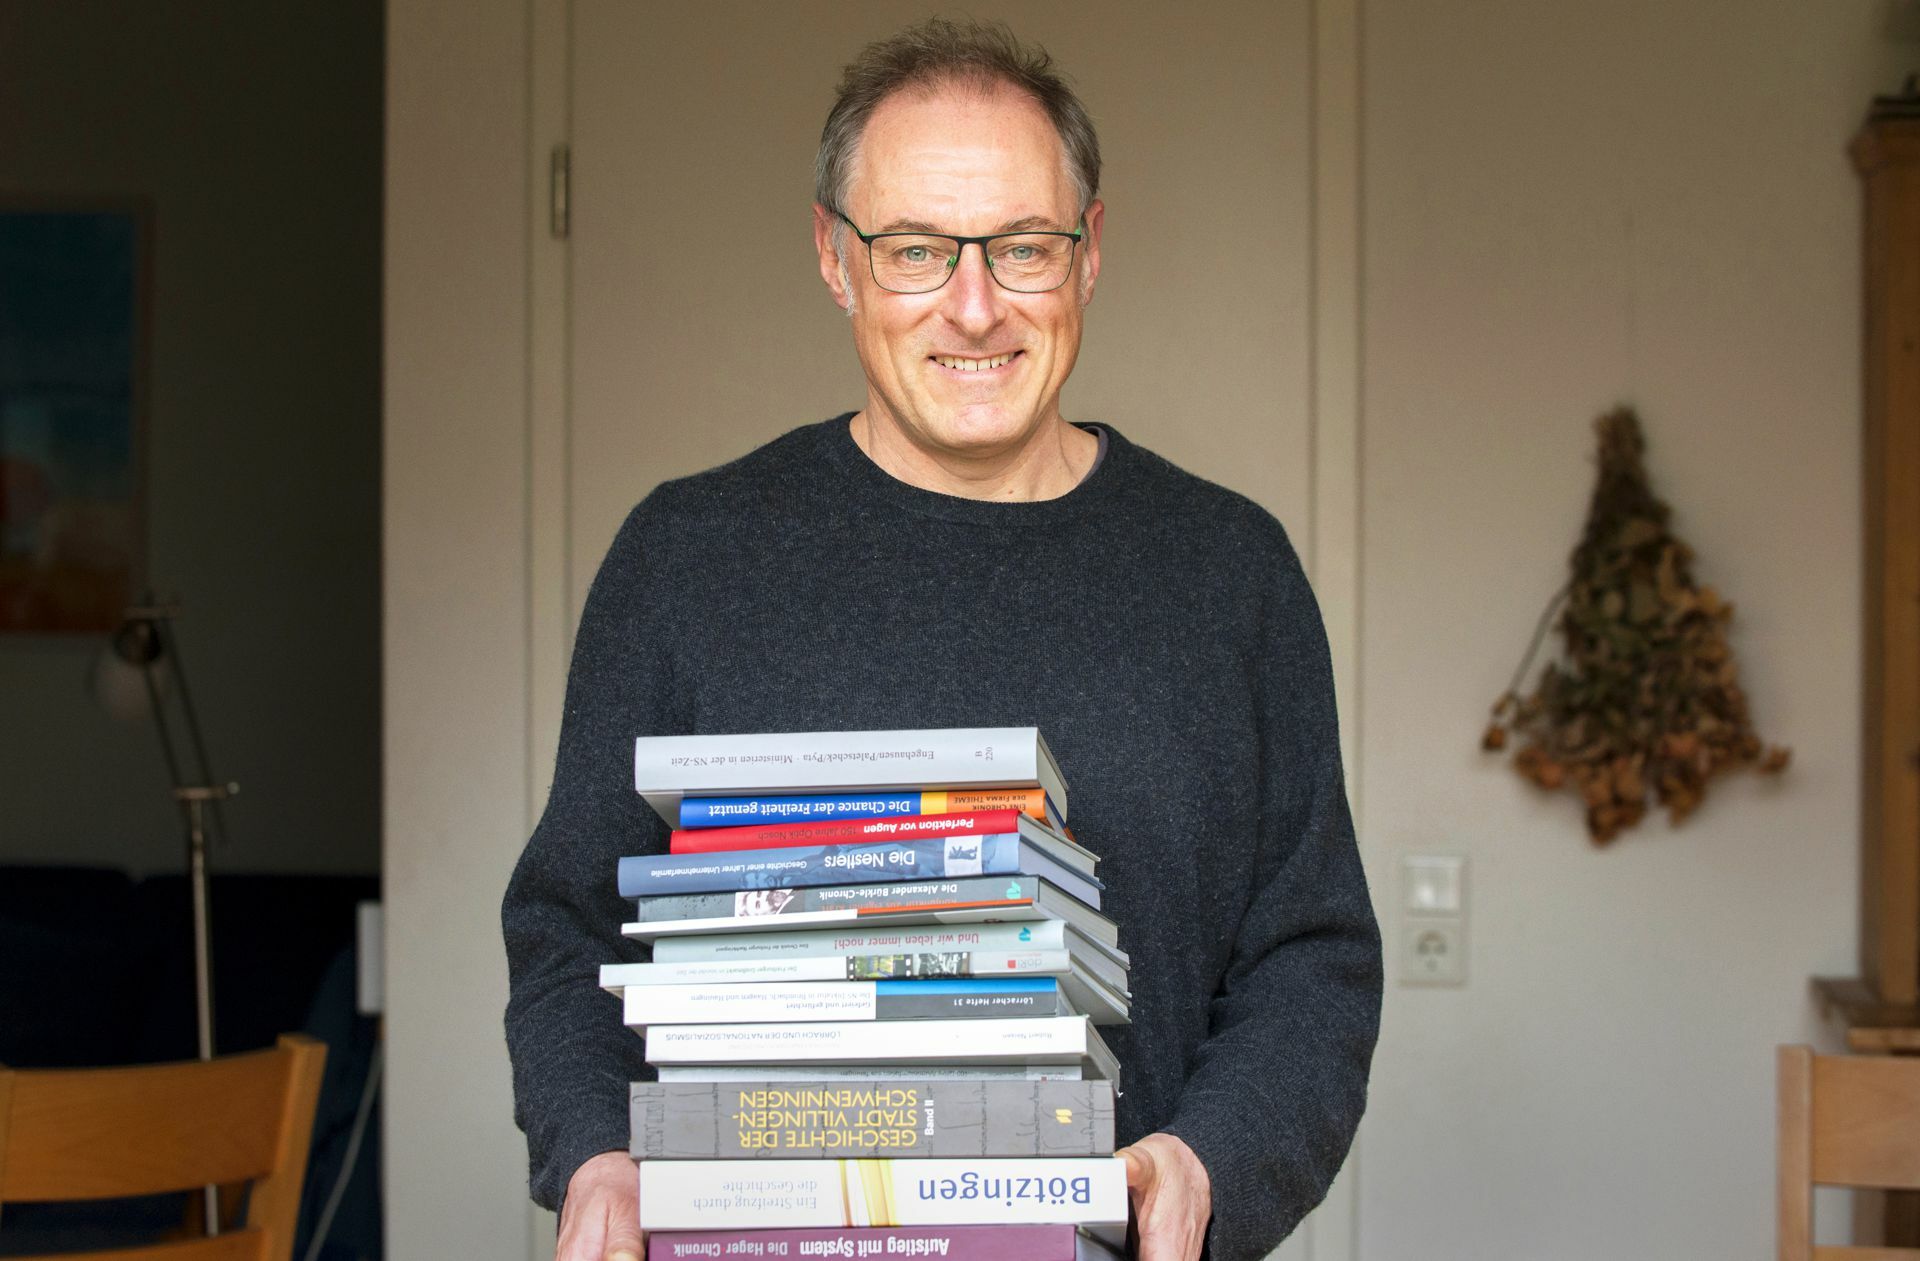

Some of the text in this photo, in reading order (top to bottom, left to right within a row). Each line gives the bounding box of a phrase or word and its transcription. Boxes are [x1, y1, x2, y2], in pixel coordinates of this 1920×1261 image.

[710, 756, 724, 766] der
[728, 756, 737, 765] in
[739, 754, 793, 765] Ministerien
[985, 747, 993, 760] 220
[671, 757, 708, 767] NS-Zeit
[709, 800, 911, 817] Die Chance der Freiheit genutzt
[863, 818, 974, 833] Perfektion vor Augen
[758, 827, 856, 841] 150 Jahre Optik Nosch
[824, 850, 915, 870] Die Nestlers
[650, 860, 807, 878] Geschichte einer Lahrer Unternehmerfamilie
[818, 883, 958, 900] Die Alexander Bürkle-Chronik
[834, 932, 980, 950] Und wir leben immer noch!
[785, 1000, 824, 1010] gefürchtet
[825, 1002, 840, 1010] und
[953, 996, 1034, 1007] Lörracher Hefte 31
[665, 1032, 763, 1041] NATIONALSOZIALISMUS
[802, 1031, 841, 1041] LÖRRACH
[739, 1089, 917, 1108] SCHWENNINGEN
[732, 1109, 917, 1128] STADT VILLINGEN-
[924, 1099, 934, 1136] Band II
[738, 1128, 917, 1147] GESCHICHTE DER
[722, 1180, 818, 1194] die Geschichte
[919, 1171, 1092, 1208] Bötzingen
[692, 1193, 817, 1210] Ein Streifzug durch
[672, 1238, 788, 1257] Die Hager Chronik
[799, 1235, 951, 1257] Aufstieg mit System
